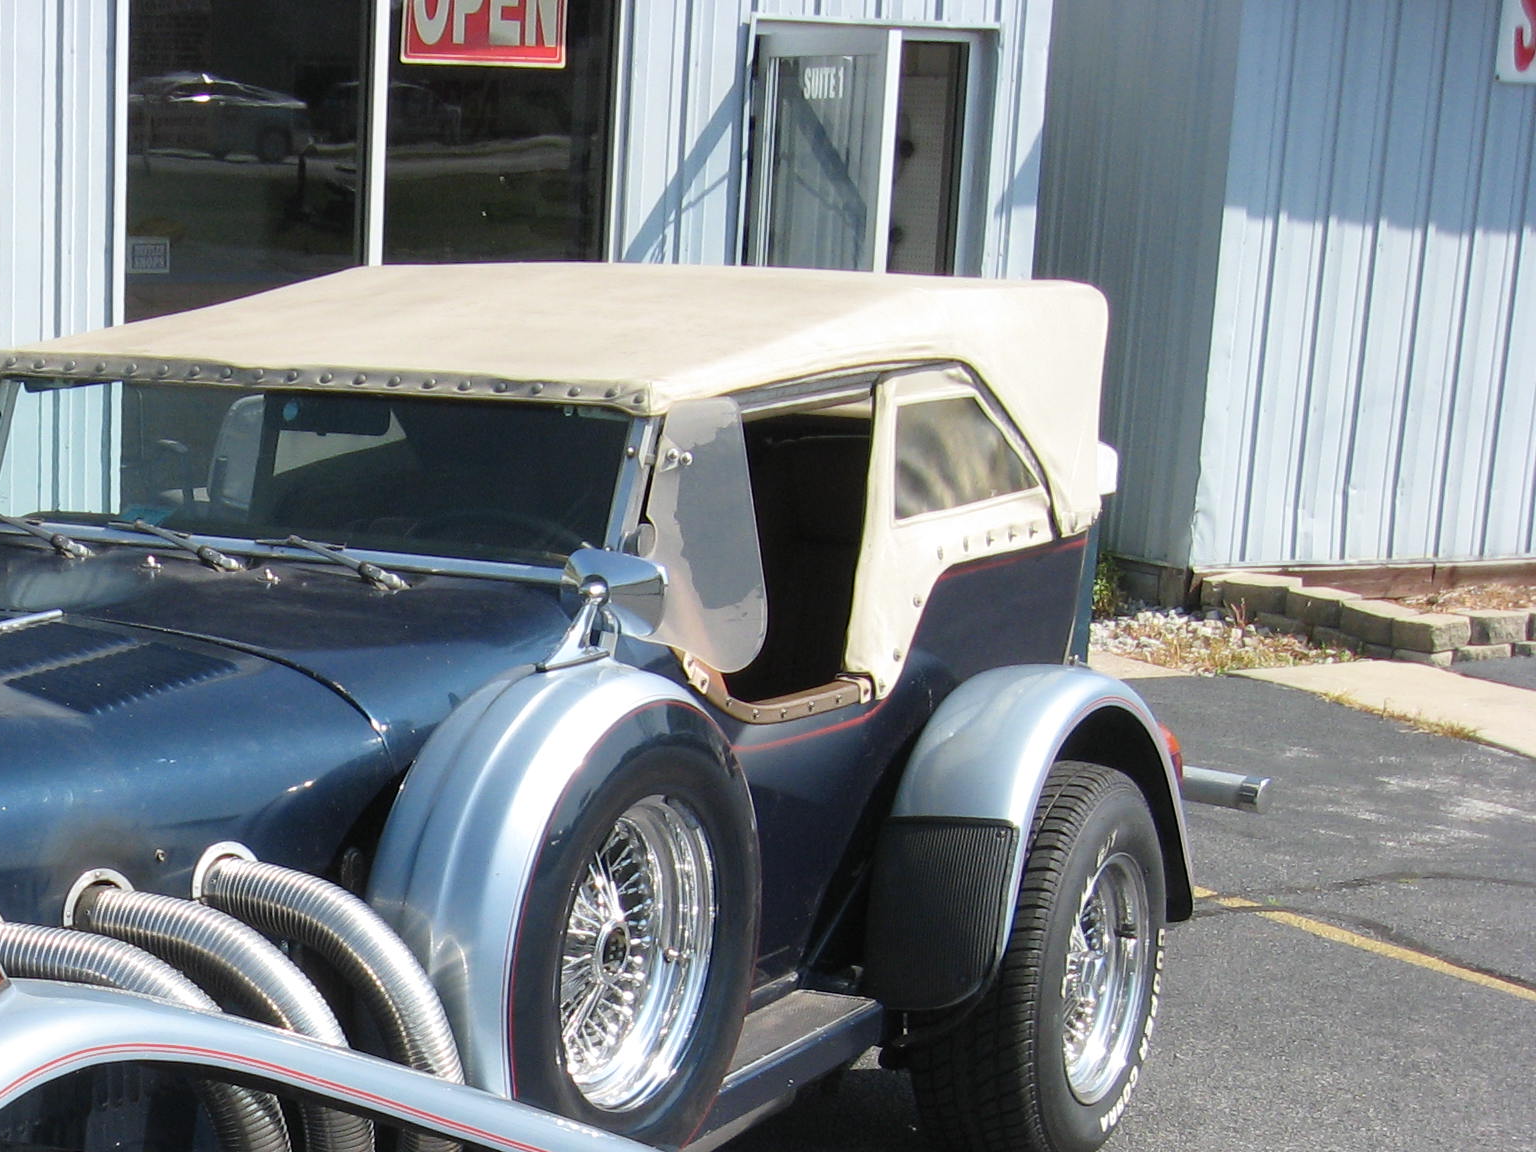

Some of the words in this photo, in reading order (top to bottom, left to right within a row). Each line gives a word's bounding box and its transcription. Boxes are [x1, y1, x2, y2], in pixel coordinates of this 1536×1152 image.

[804, 67, 835, 99] SUITE
[838, 66, 844, 98] 1
[1100, 1065, 1139, 1132] COBRA
